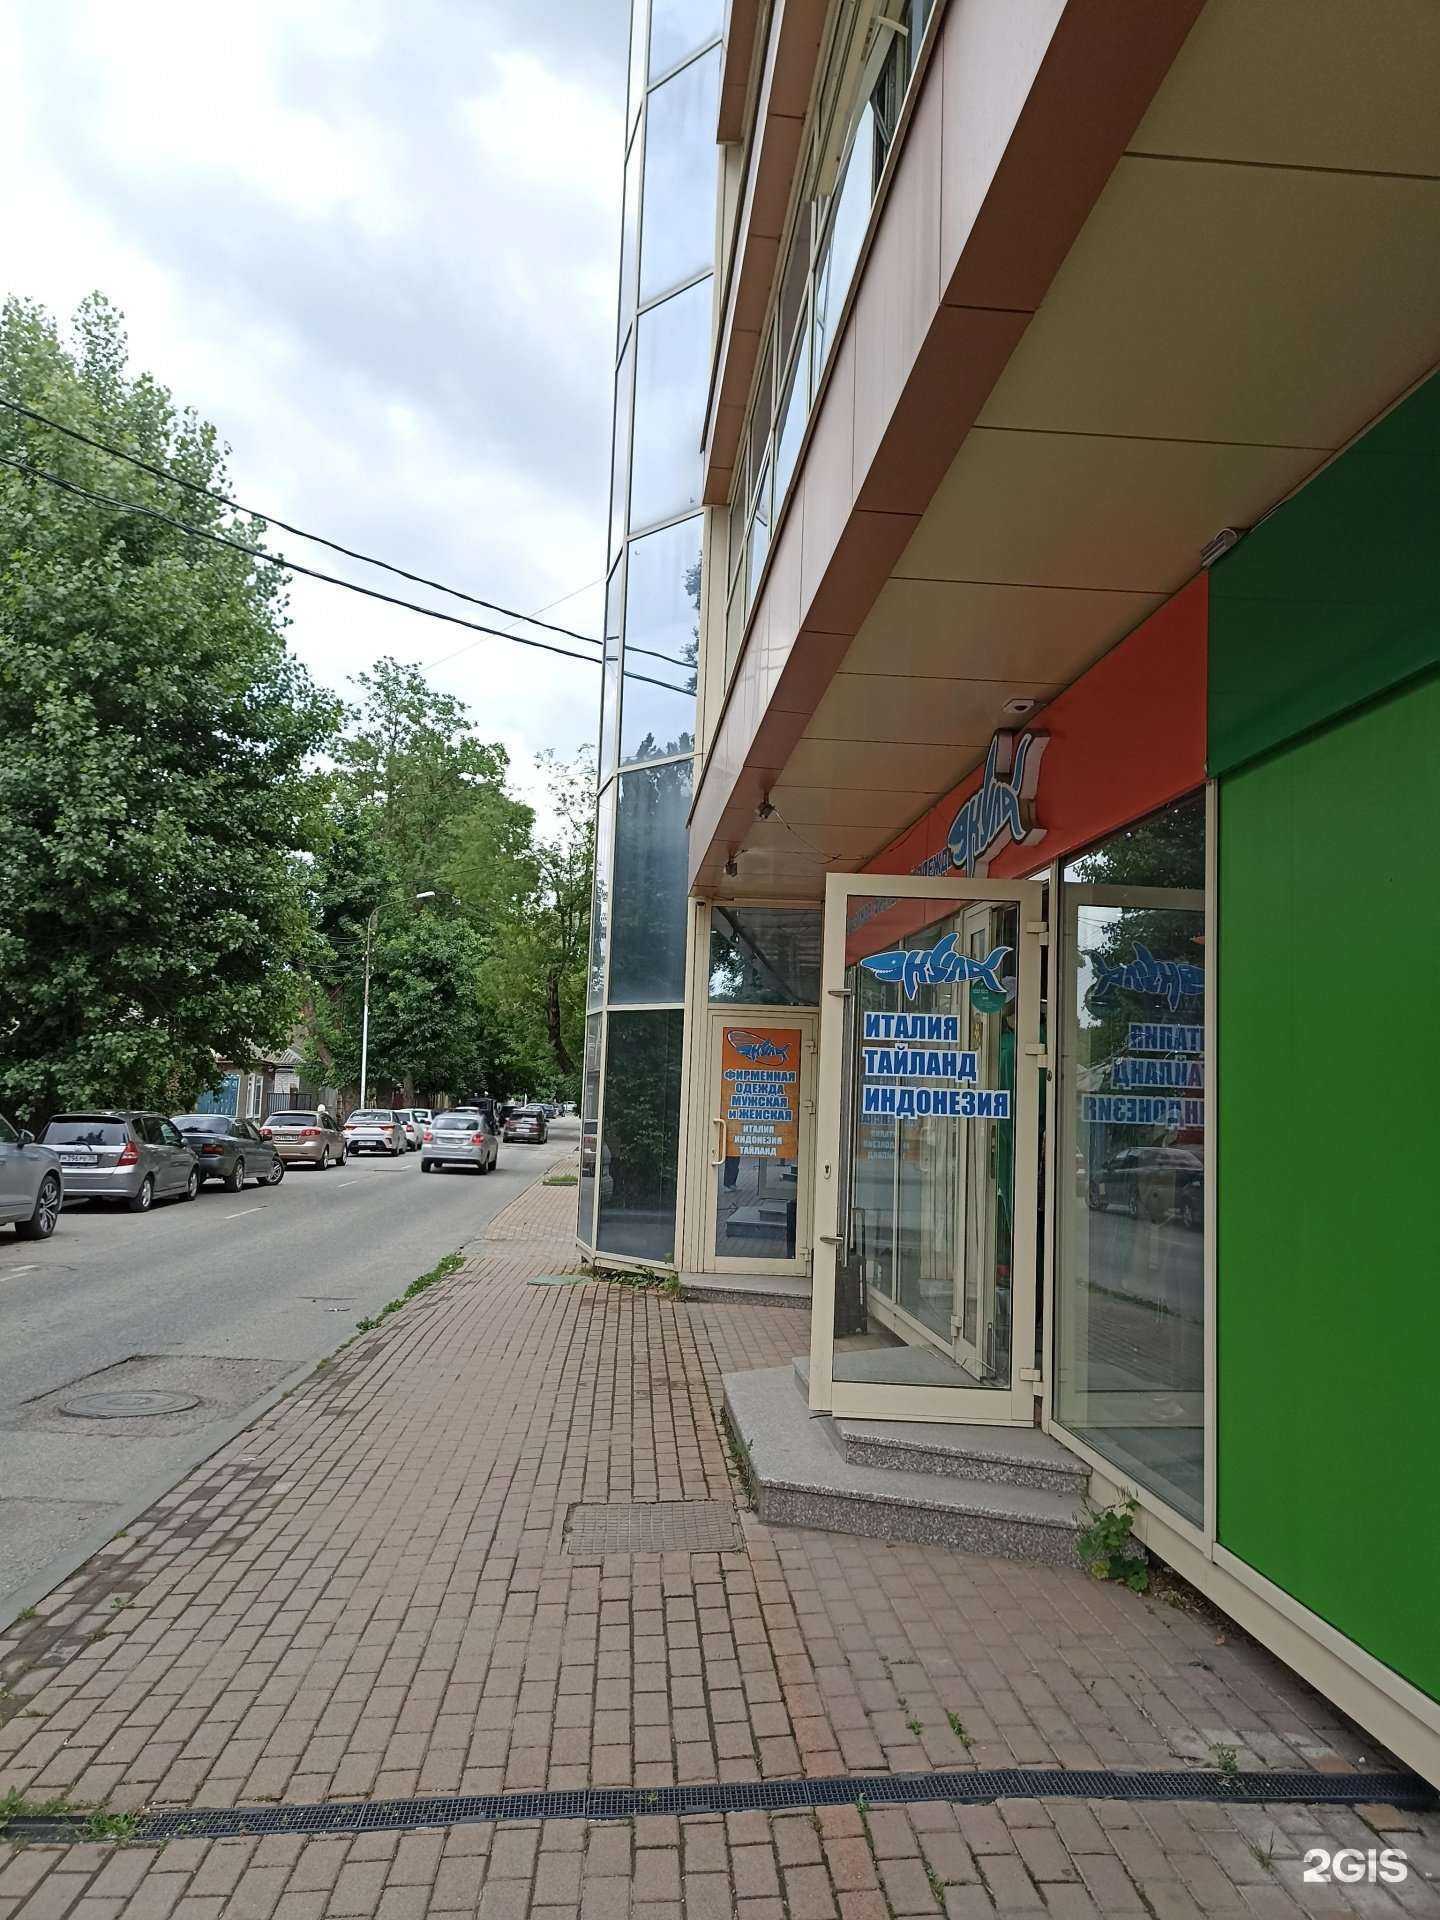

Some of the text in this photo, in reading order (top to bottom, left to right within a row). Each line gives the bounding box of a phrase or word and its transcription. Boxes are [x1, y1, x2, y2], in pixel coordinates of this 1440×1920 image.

[864, 1013, 959, 1041] ИТАЛИЯ
[864, 1044, 977, 1082] ТАЙЛАНД
[724, 1069, 796, 1082] ФИРМЕННАЯ
[735, 1082, 785, 1095] ОДЕЖДА
[731, 1095, 788, 1108] МУЖСКАЯ
[864, 1087, 1009, 1118] ИНДОНЕЗИЯ
[738, 1108, 792, 1121] ЖЕНСКАЯ
[743, 1124, 775, 1134] ИТАЛИЯ
[734, 1135, 783, 1145] ИНДОНЕЗИЯ
